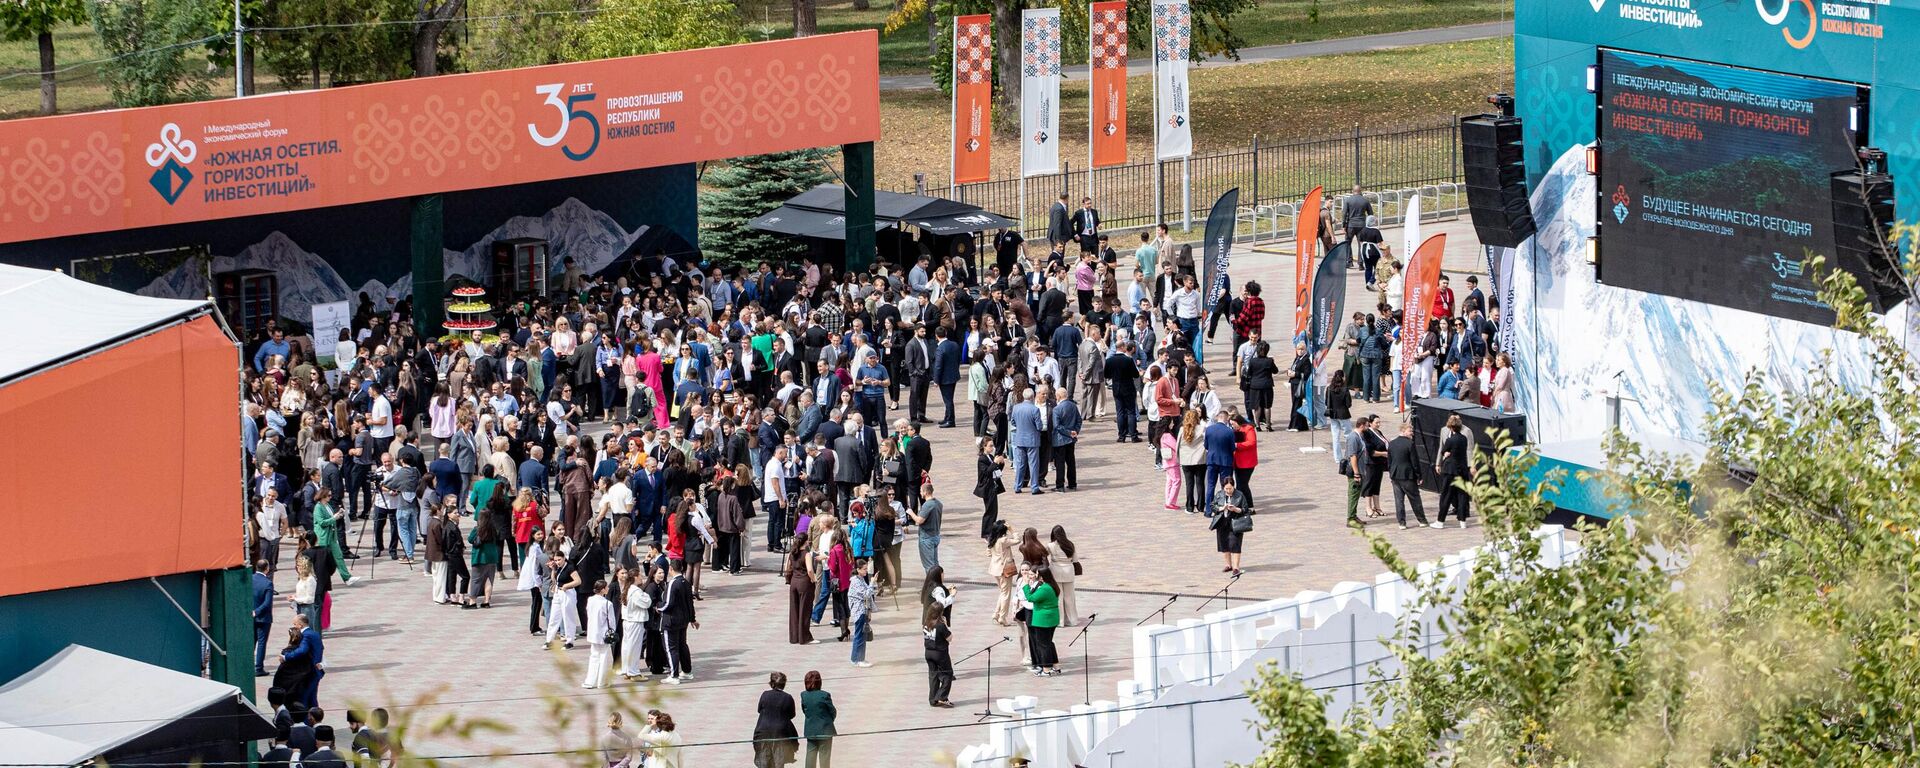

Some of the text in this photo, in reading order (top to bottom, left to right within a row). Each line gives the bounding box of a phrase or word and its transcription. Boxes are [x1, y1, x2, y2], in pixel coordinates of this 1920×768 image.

[1620, 4, 1702, 28] ИНВЕСТИЦИЙ»
[1822, 3, 1870, 20] РЕСПУБЛИКИ
[1822, 19, 1883, 38] ЮЖНАЯ ОСЕТИЯ
[572, 83, 593, 93] ЛЕТ
[1617, 74, 1697, 96] МЕЖДУНАРОДНЫЙ
[1700, 86, 1779, 108] ЭКОНОМИЧЕСКИЙ
[1780, 98, 1814, 114] ФОРУМ
[607, 90, 683, 110] ПРОВОЗГЛАШЕНИЯ
[528, 83, 600, 161] 35
[607, 108, 661, 125] РЕСПУБЛИКИ
[1612, 92, 1810, 136] «ЮЖНАЯ ОСЕТИЯ. ГОРИЗОНТЫ
[204, 128, 288, 143] экономический форум
[208, 119, 271, 134] Международный
[607, 121, 675, 140] ЮЖНАЯ ОСЕТИЯ
[1612, 112, 1703, 140] ИНВЕСТИЦИЙ»
[204, 140, 342, 167] «ЮЖНАЯ ОСЕТИЯ.
[204, 162, 298, 185] ГОРИЗОНТЫ
[204, 174, 316, 203] ИНВЕСТИЦИЙ»
[1642, 195, 1812, 237] БУДУЩЕЕ НАЧИНАЕТСЯ СЕГОДНЯ
[1642, 212, 1673, 226] ОТКРЫТИЕ
